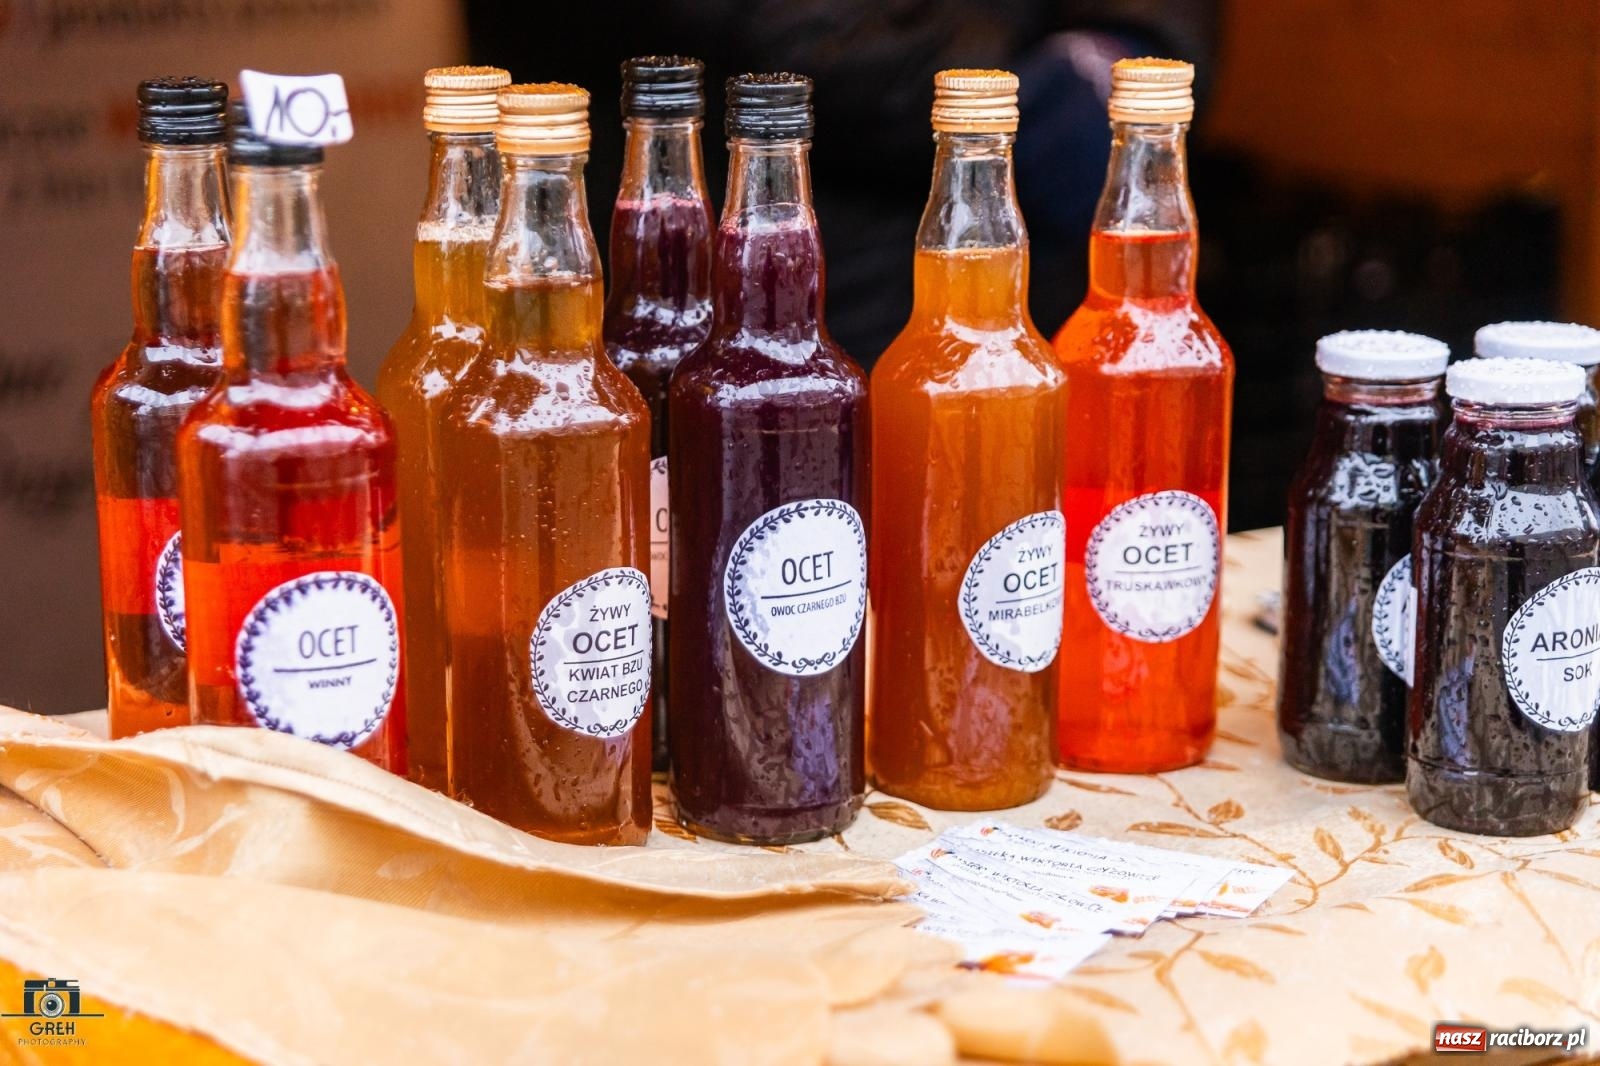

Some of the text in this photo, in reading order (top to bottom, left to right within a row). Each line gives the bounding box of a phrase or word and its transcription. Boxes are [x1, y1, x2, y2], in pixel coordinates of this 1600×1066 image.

[1122, 542, 1194, 565] OCET
[781, 550, 834, 585] OCET
[1003, 563, 1058, 593] OCET
[589, 603, 632, 622] ŻYWY
[771, 593, 847, 617] OWOC CZARNEGO BZU
[299, 625, 359, 658] OCET
[572, 623, 639, 654] OCET
[1530, 623, 1600, 653] ARONI
[569, 657, 643, 681] KWIAT BZU
[1563, 661, 1593, 682] SOK
[308, 676, 352, 689] WINNY
[567, 679, 643, 703] CZARNEGO
